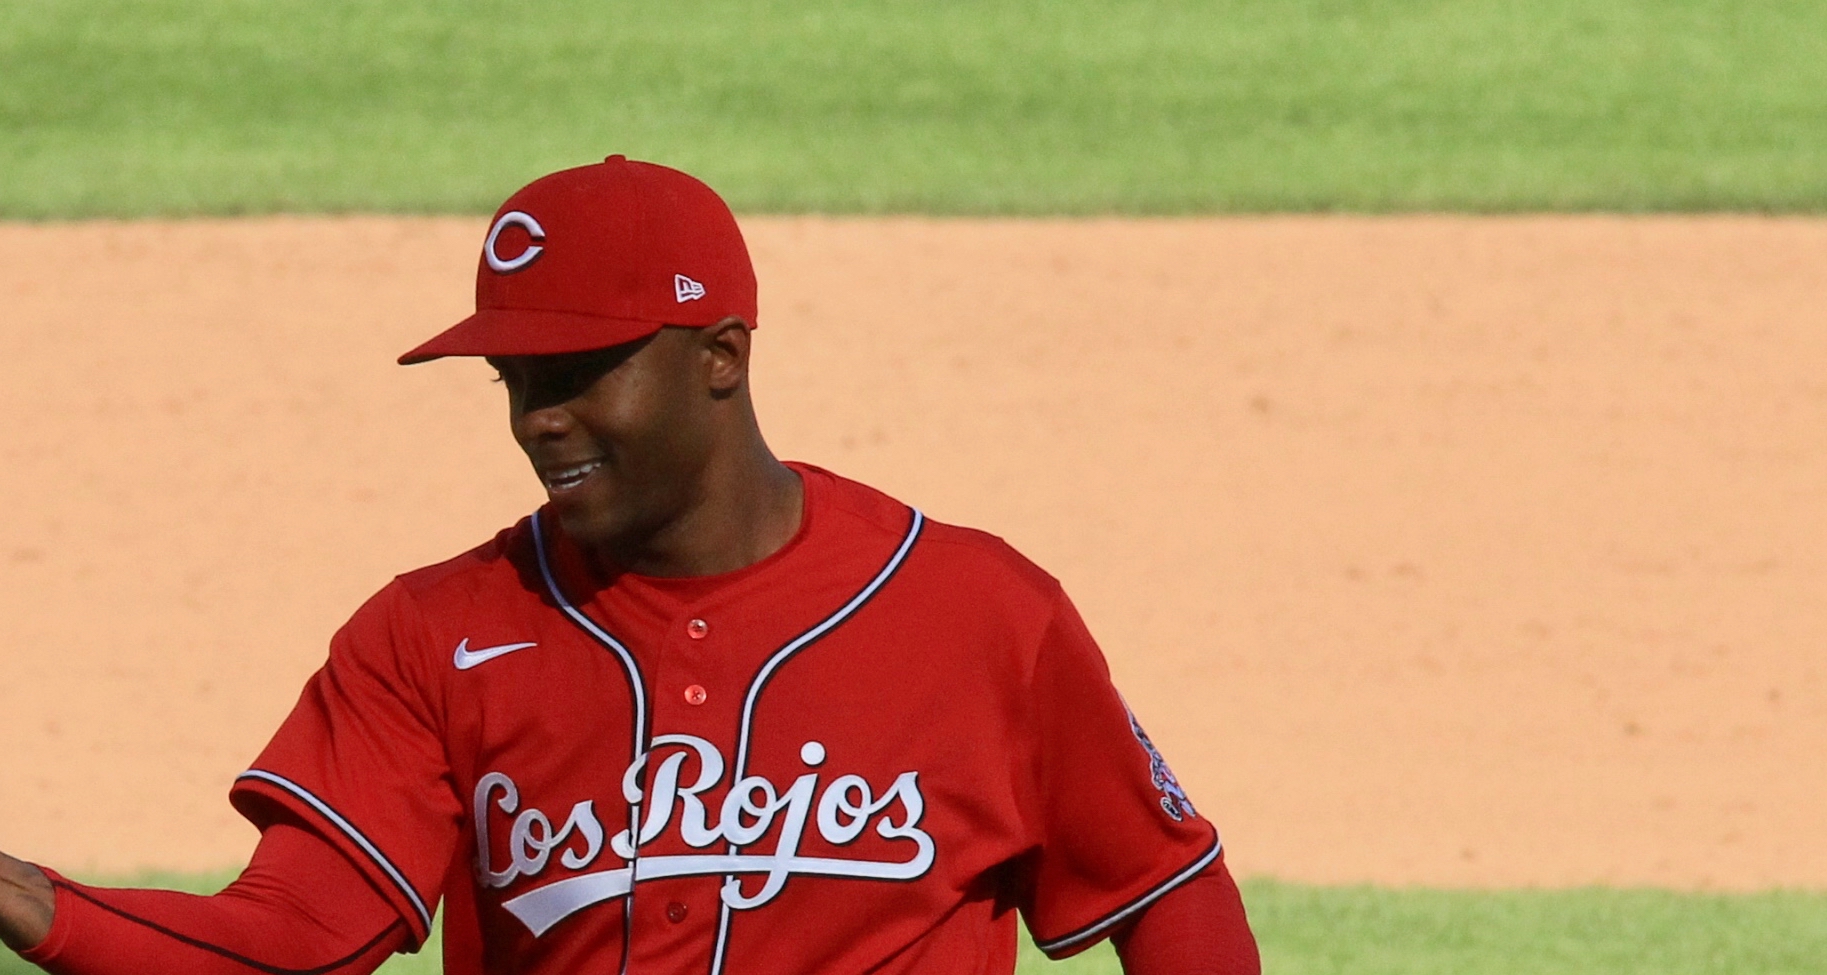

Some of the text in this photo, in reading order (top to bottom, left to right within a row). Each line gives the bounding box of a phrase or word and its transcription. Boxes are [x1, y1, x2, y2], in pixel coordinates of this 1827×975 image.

[484, 210, 546, 272] C
[473, 734, 935, 909] Los Rojos
